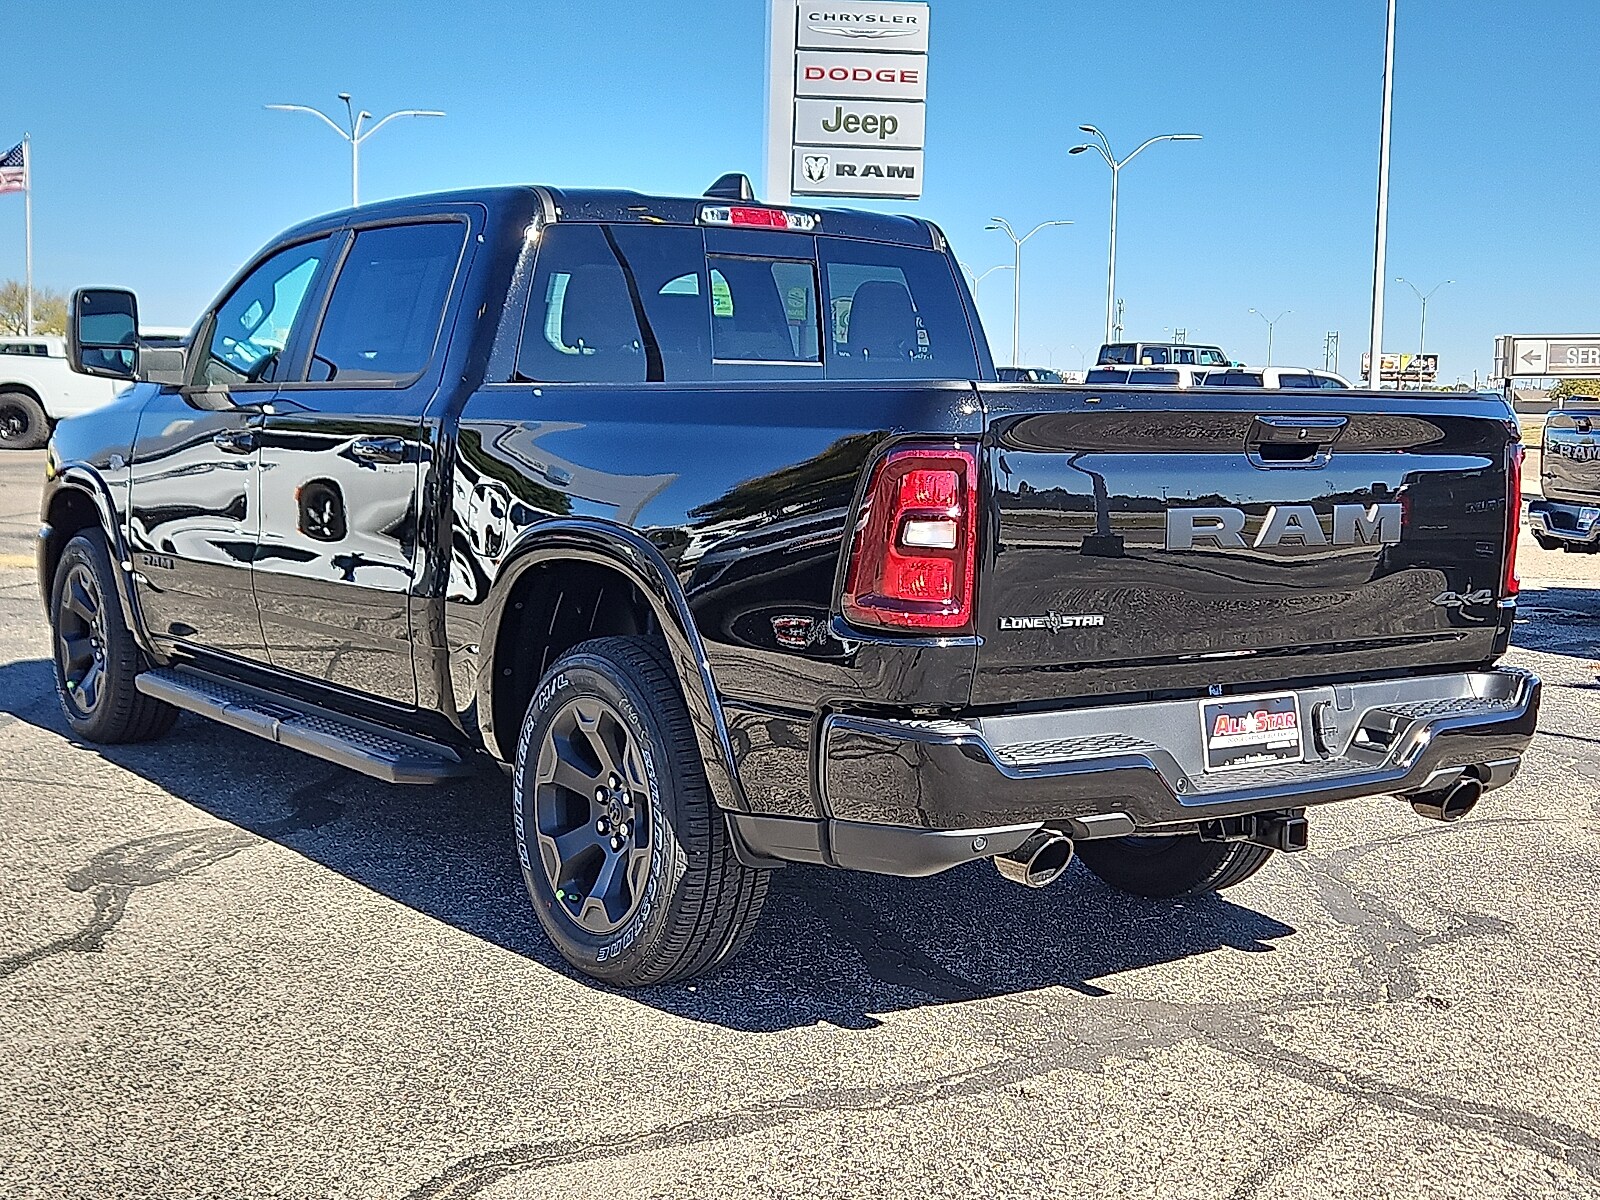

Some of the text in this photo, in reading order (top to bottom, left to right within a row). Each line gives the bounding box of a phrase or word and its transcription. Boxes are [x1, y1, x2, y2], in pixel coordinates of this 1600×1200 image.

[809, 12, 917, 24] CHRYSLER
[805, 67, 918, 83] DODGE
[822, 107, 898, 139] Jeep
[836, 163, 915, 179] RAM
[1166, 502, 1403, 550] RAM
[143, 555, 174, 570] RAM
[999, 615, 1104, 630] LONE STAR
[537, 673, 570, 711] H/L
